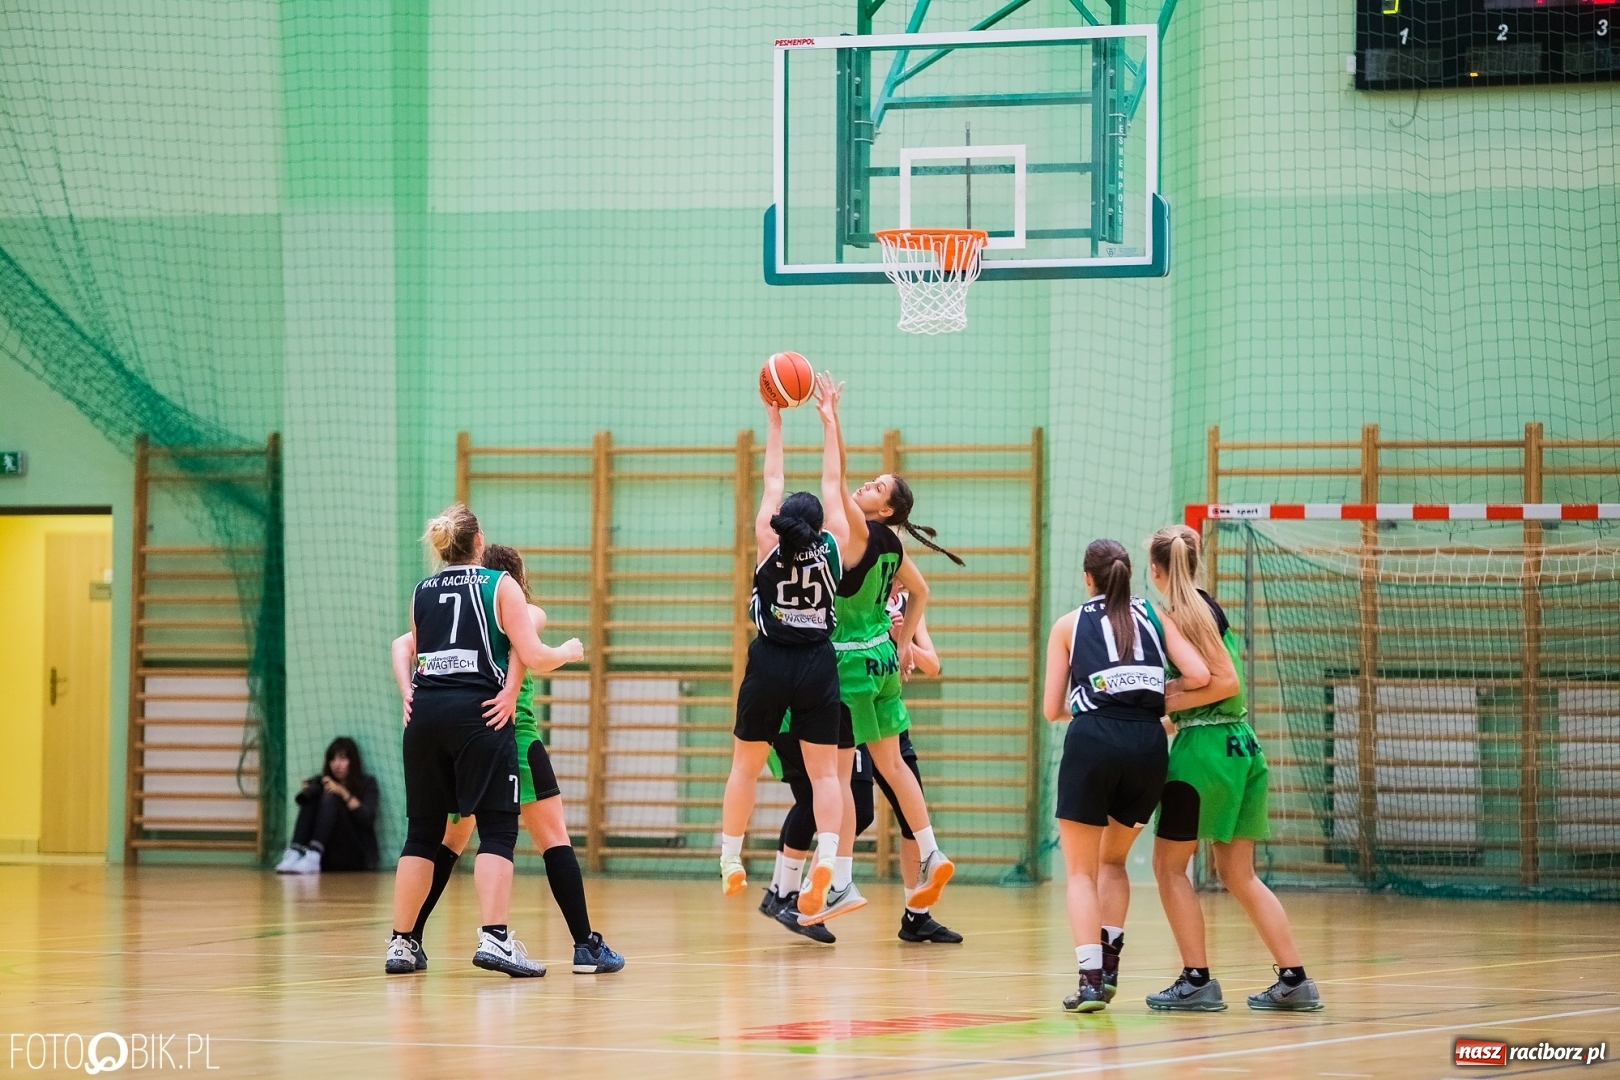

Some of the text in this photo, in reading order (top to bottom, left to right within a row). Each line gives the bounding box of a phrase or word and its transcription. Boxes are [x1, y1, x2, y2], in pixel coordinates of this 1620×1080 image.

[1399, 27, 1410, 45] 1
[1496, 24, 1509, 41] 2
[1596, 19, 1609, 36] 3
[774, 38, 815, 47] PESMENPOL
[776, 561, 825, 607] 25
[438, 592, 462, 644] 7
[426, 659, 475, 671] WAGTECH
[1106, 675, 1163, 689] WAGTECH
[508, 774, 519, 803] 7
